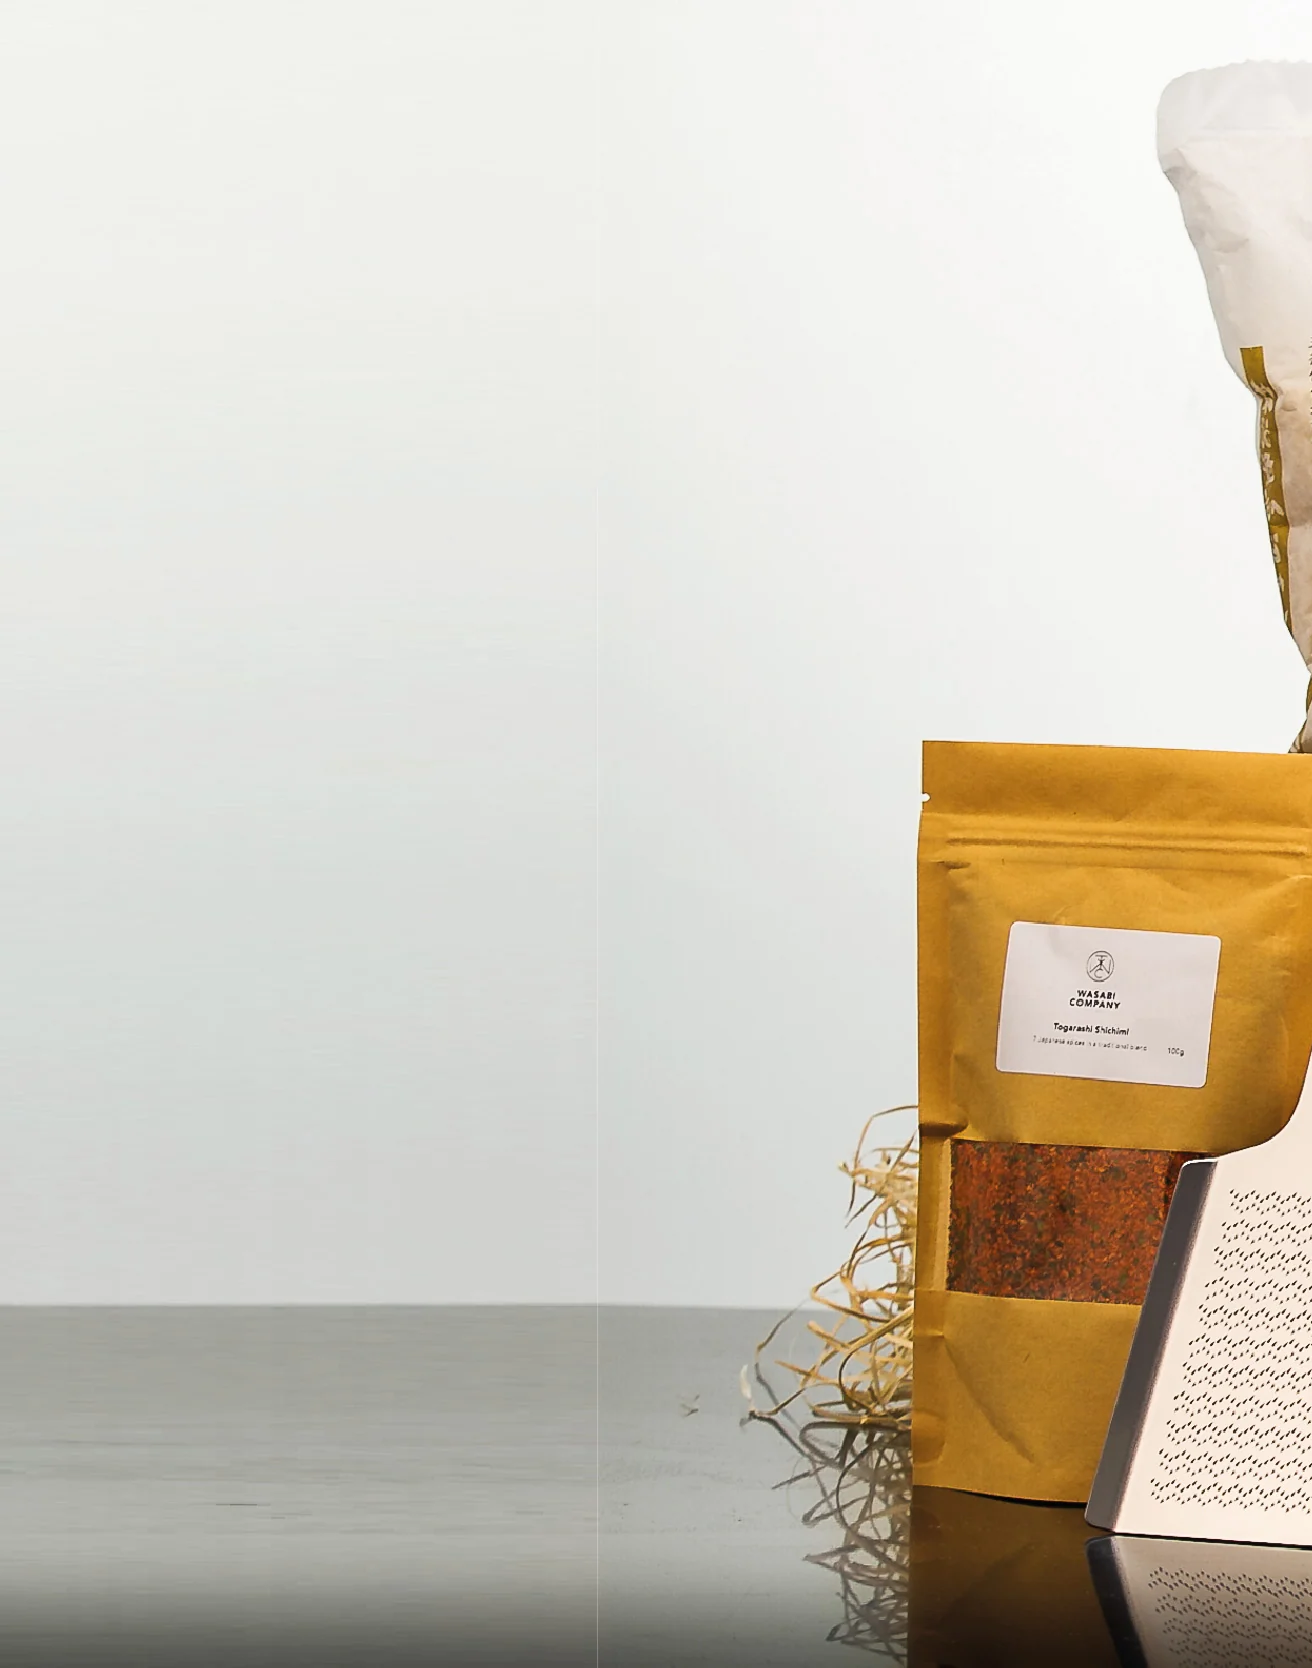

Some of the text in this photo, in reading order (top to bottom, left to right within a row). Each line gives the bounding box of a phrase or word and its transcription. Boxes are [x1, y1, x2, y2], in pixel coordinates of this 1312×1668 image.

[1076, 989, 1115, 1000] WASABI
[1069, 998, 1121, 1009] COMPANY
[1053, 1022, 1129, 1036] Togarashi Shichimi
